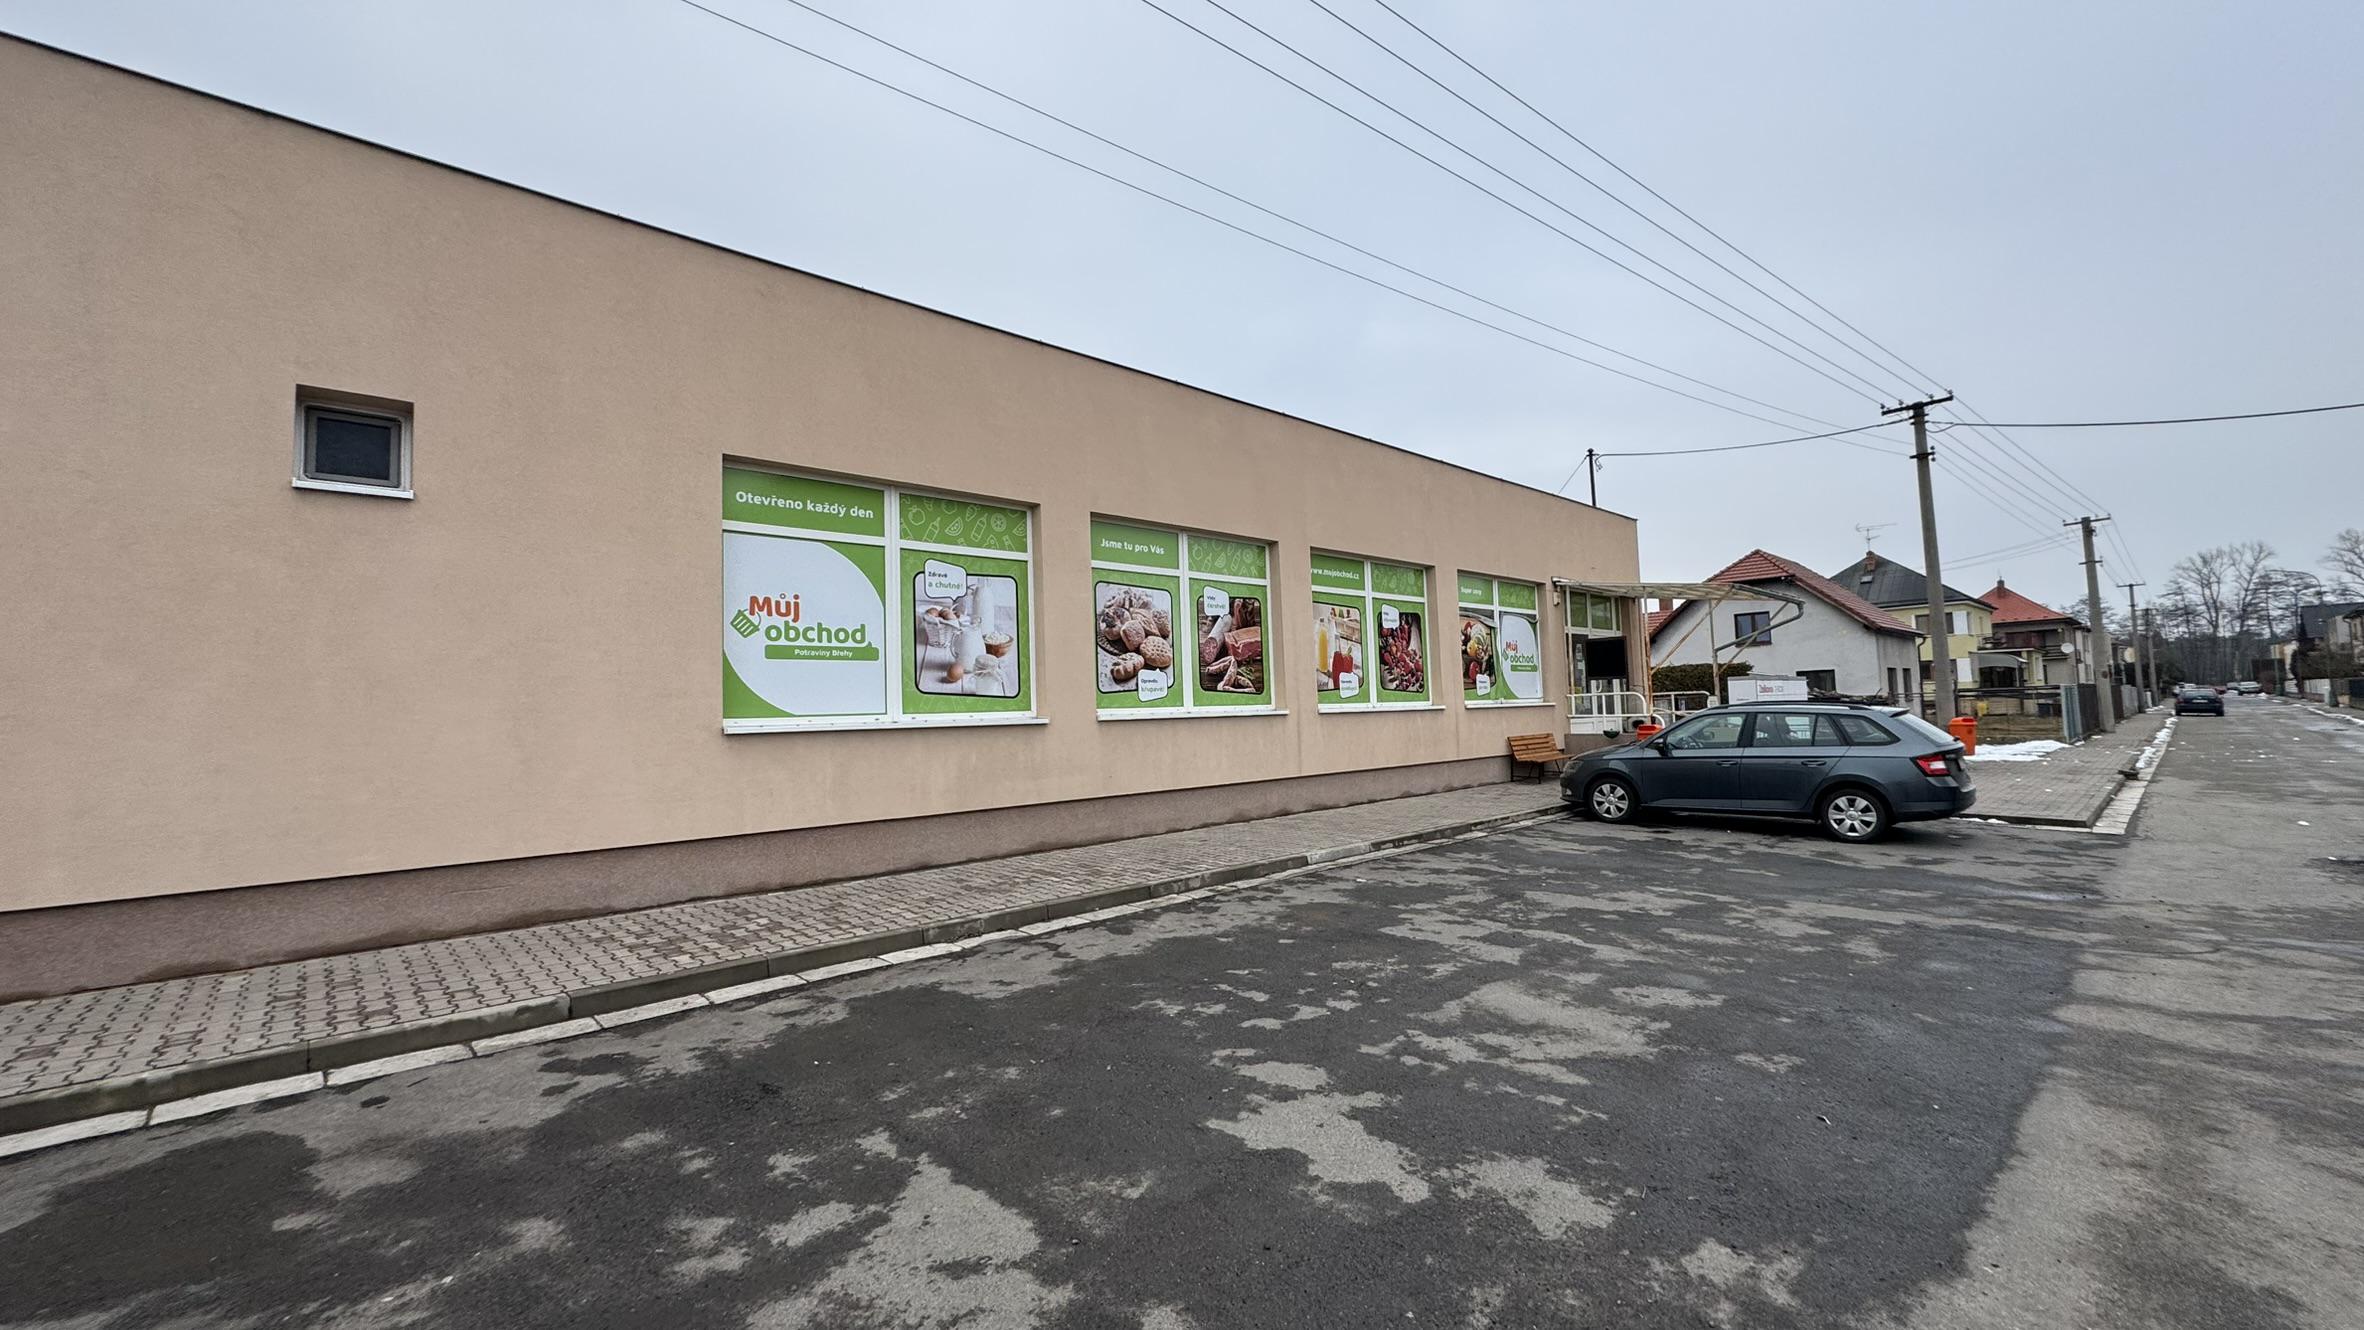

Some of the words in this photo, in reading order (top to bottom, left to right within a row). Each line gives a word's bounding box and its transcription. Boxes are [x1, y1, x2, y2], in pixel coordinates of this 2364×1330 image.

[735, 491, 803, 511] Otevřeno
[806, 500, 847, 518] každý
[850, 505, 874, 519] den
[1101, 539, 1122, 549] Jsme
[1124, 542, 1133, 551] tu
[1134, 543, 1148, 553] pro
[1150, 543, 1165, 555] Vás
[748, 592, 801, 624] Můj
[764, 621, 867, 645] obchod
[794, 648, 832, 659] Potraviny
[833, 649, 853, 659] Břehy
[1510, 653, 1534, 664] obchod
